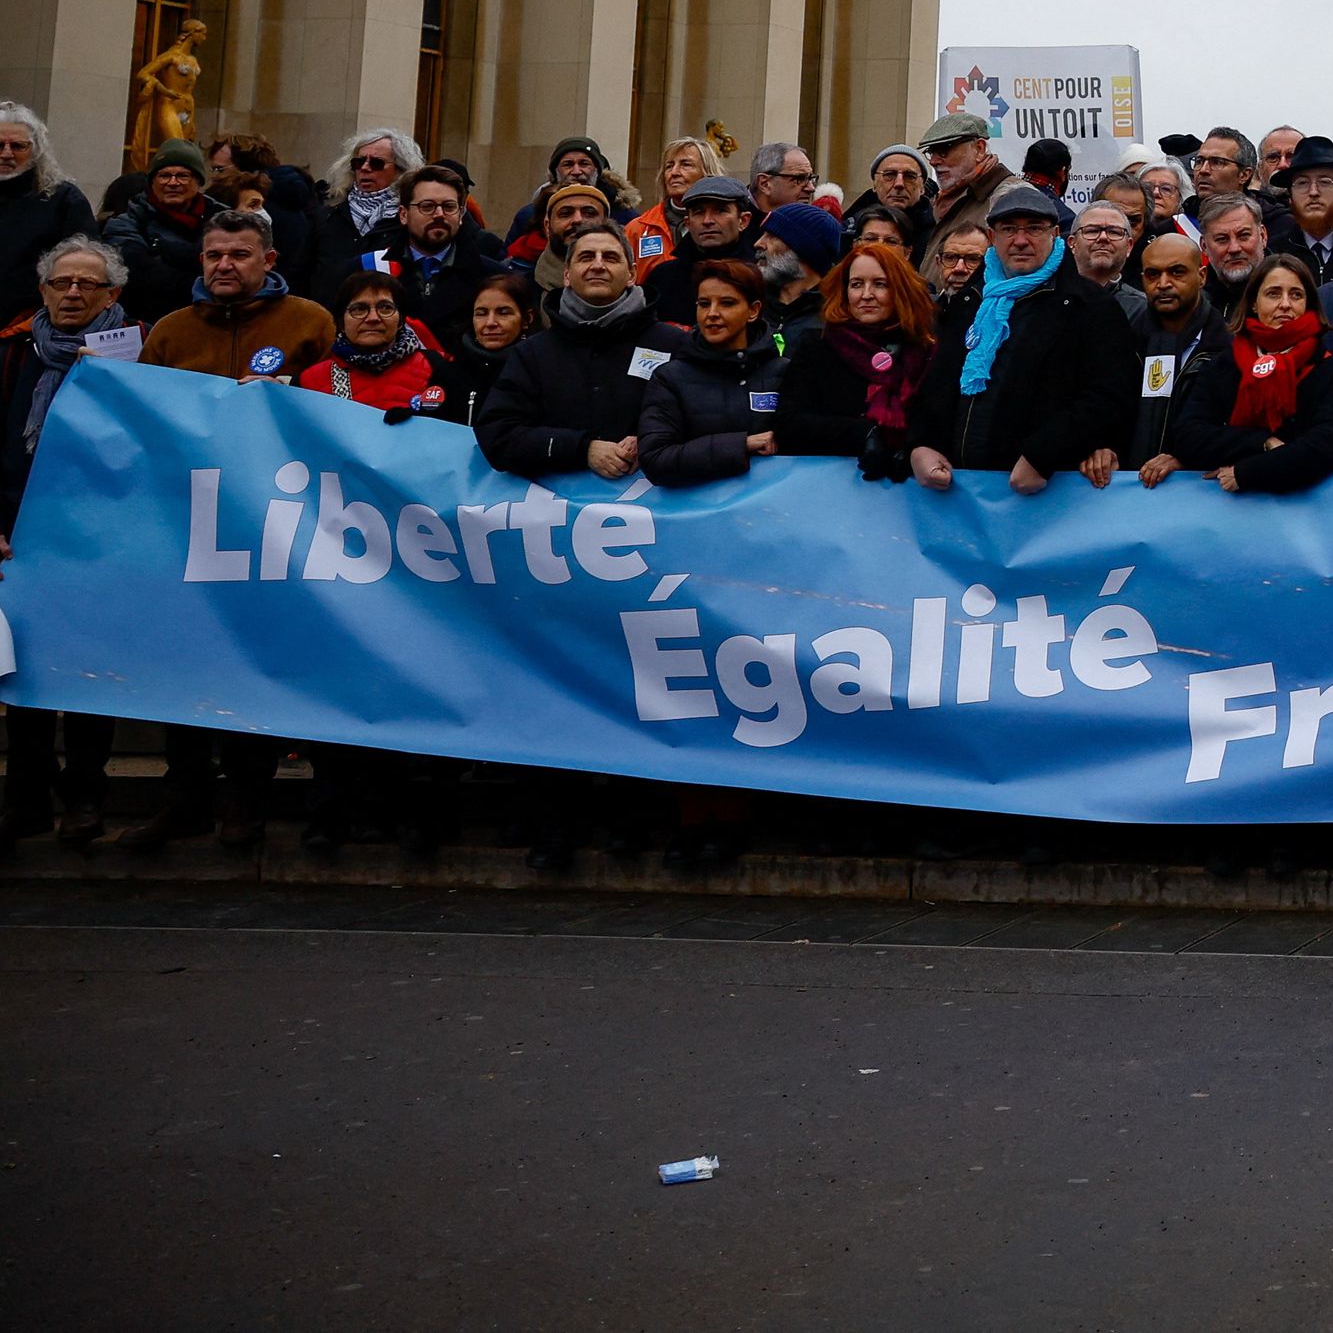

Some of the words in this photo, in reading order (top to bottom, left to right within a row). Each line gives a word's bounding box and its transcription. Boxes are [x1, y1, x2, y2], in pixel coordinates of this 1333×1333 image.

[1014, 78, 1051, 99] CENT
[1054, 76, 1102, 99] POUR
[1114, 86, 1131, 127] OISE
[1015, 108, 1045, 138] UN
[1048, 107, 1102, 138] TOIT
[1252, 360, 1275, 375] cgt
[425, 390, 441, 400] SAF
[184, 461, 656, 585] Liberté
[620, 566, 1159, 748] Égalité
